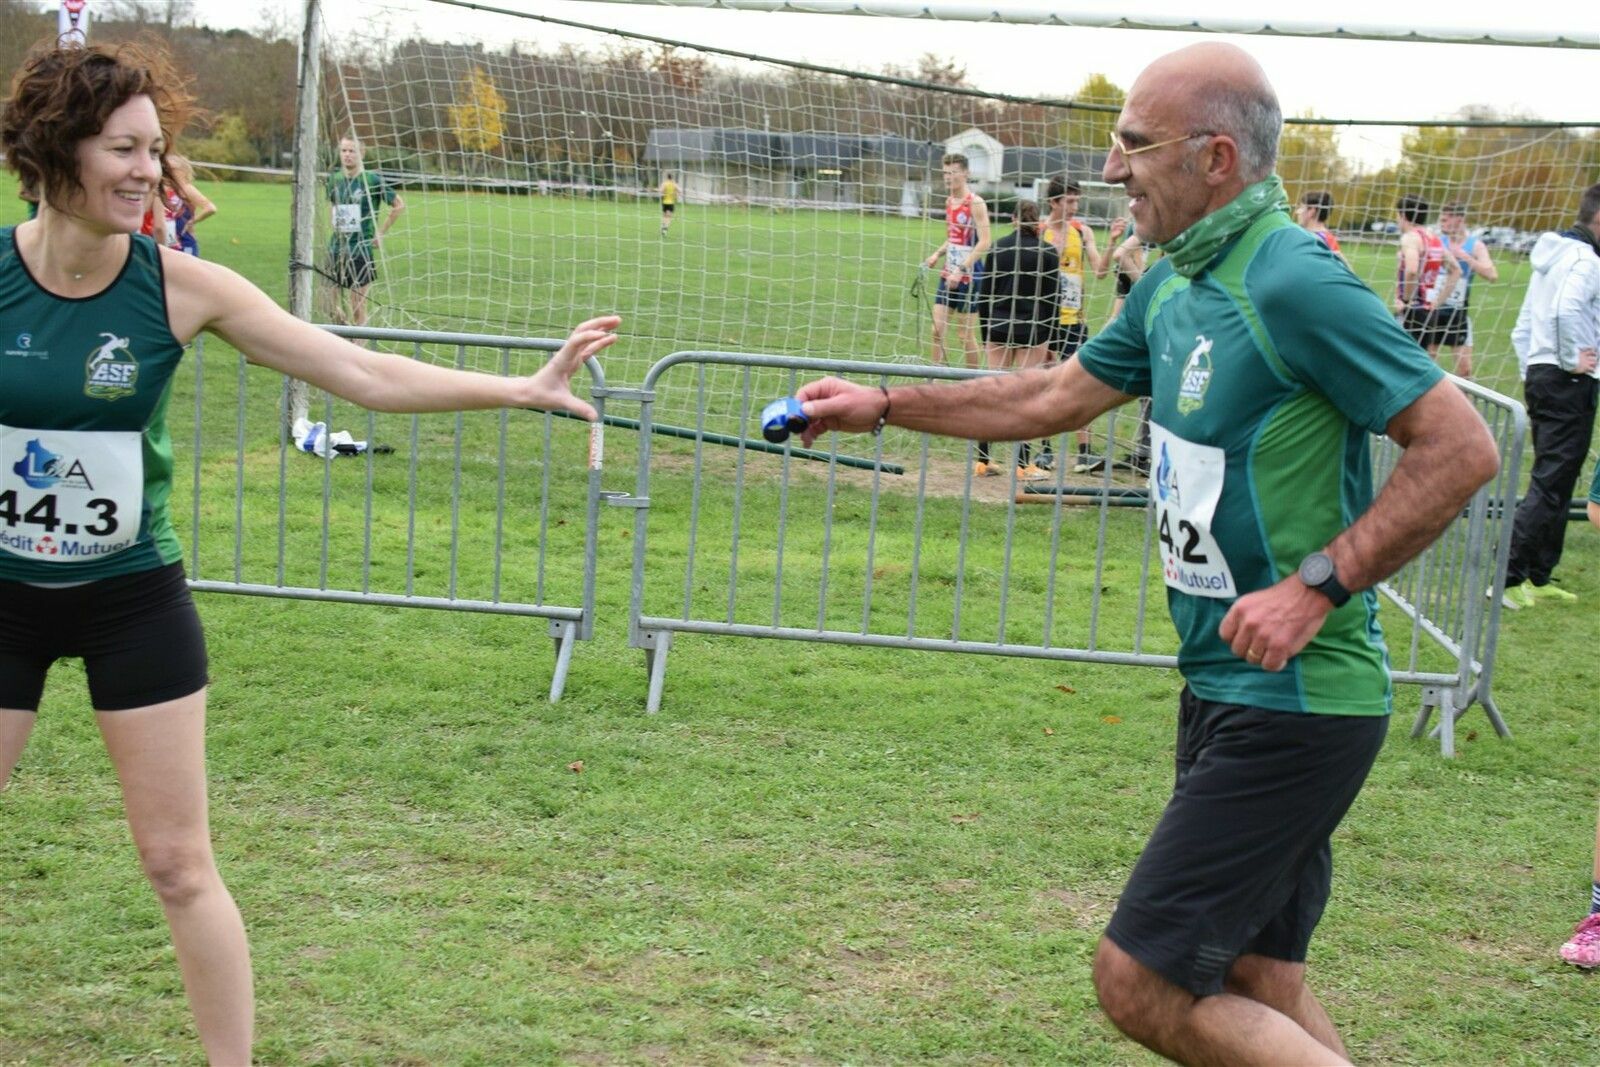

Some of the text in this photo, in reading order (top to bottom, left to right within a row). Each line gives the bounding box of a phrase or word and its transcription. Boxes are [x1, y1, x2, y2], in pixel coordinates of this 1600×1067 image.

[0, 490, 119, 536] 44.3
[0, 530, 130, 555] édit Mutuel
